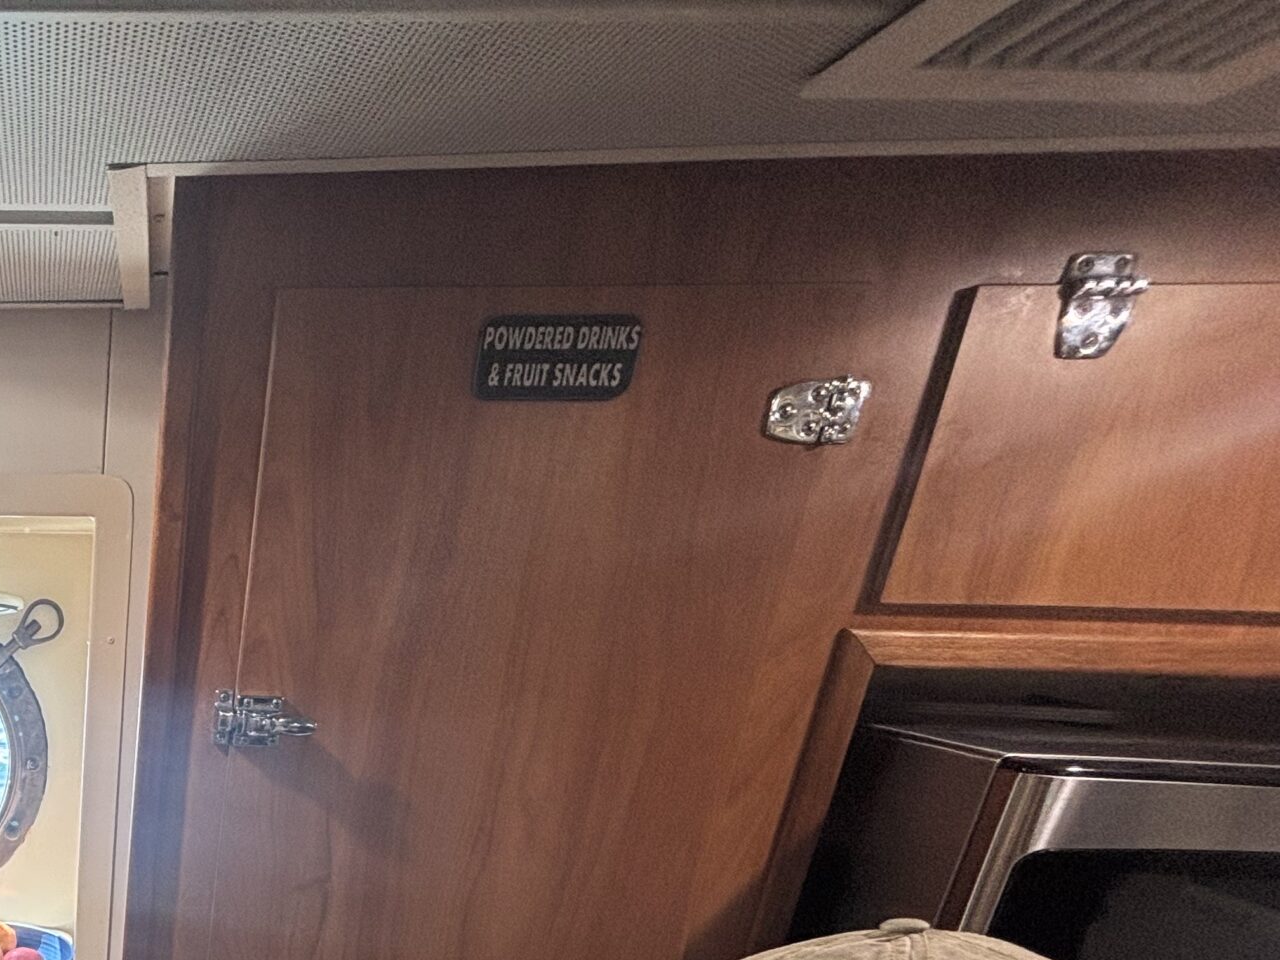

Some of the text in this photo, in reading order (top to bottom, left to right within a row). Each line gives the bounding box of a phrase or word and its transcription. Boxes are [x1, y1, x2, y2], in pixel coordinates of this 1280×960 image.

[483, 325, 641, 350] POWDERED DRINKS
[488, 362, 623, 387] & FRUIT SNACKS
